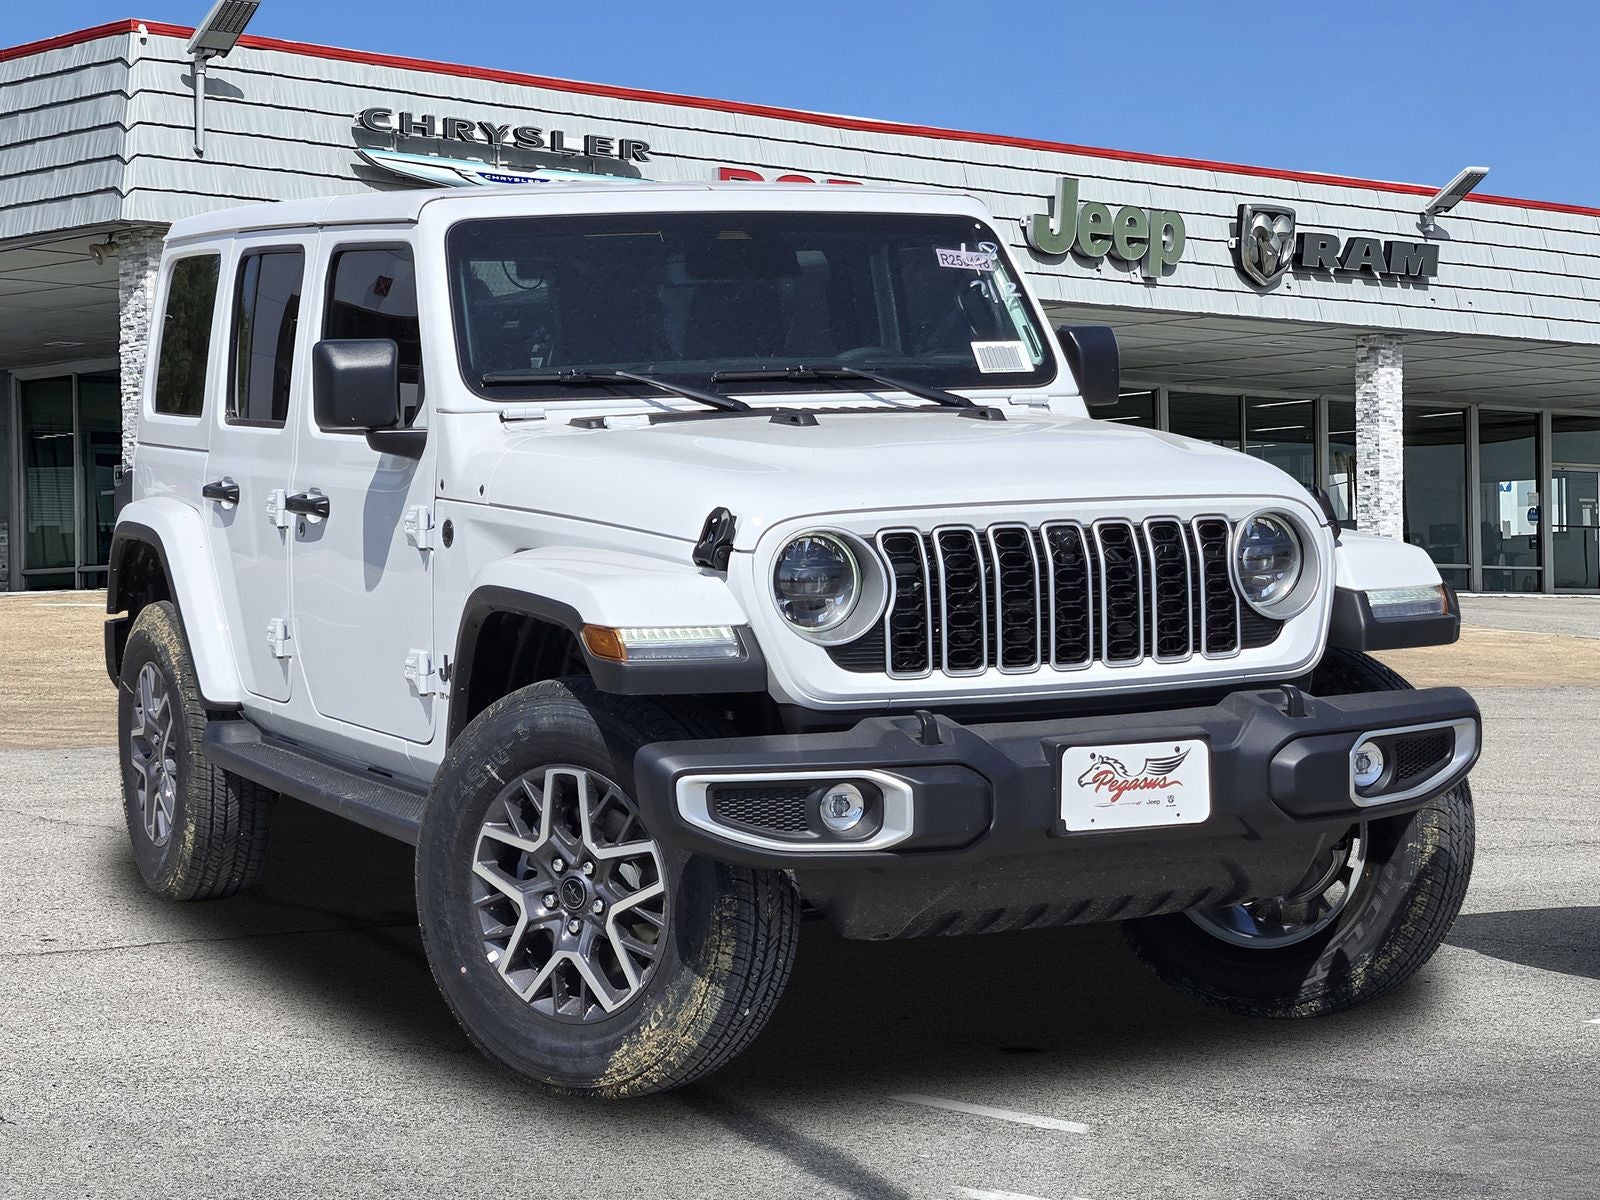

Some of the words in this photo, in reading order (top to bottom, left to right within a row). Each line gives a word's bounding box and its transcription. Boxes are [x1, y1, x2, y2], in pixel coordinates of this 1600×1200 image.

[358, 107, 650, 162] CHRYSLER
[1026, 177, 1186, 278] Jeep
[1297, 232, 1440, 278] RAM
[1092, 769, 1183, 803] Pegasus
